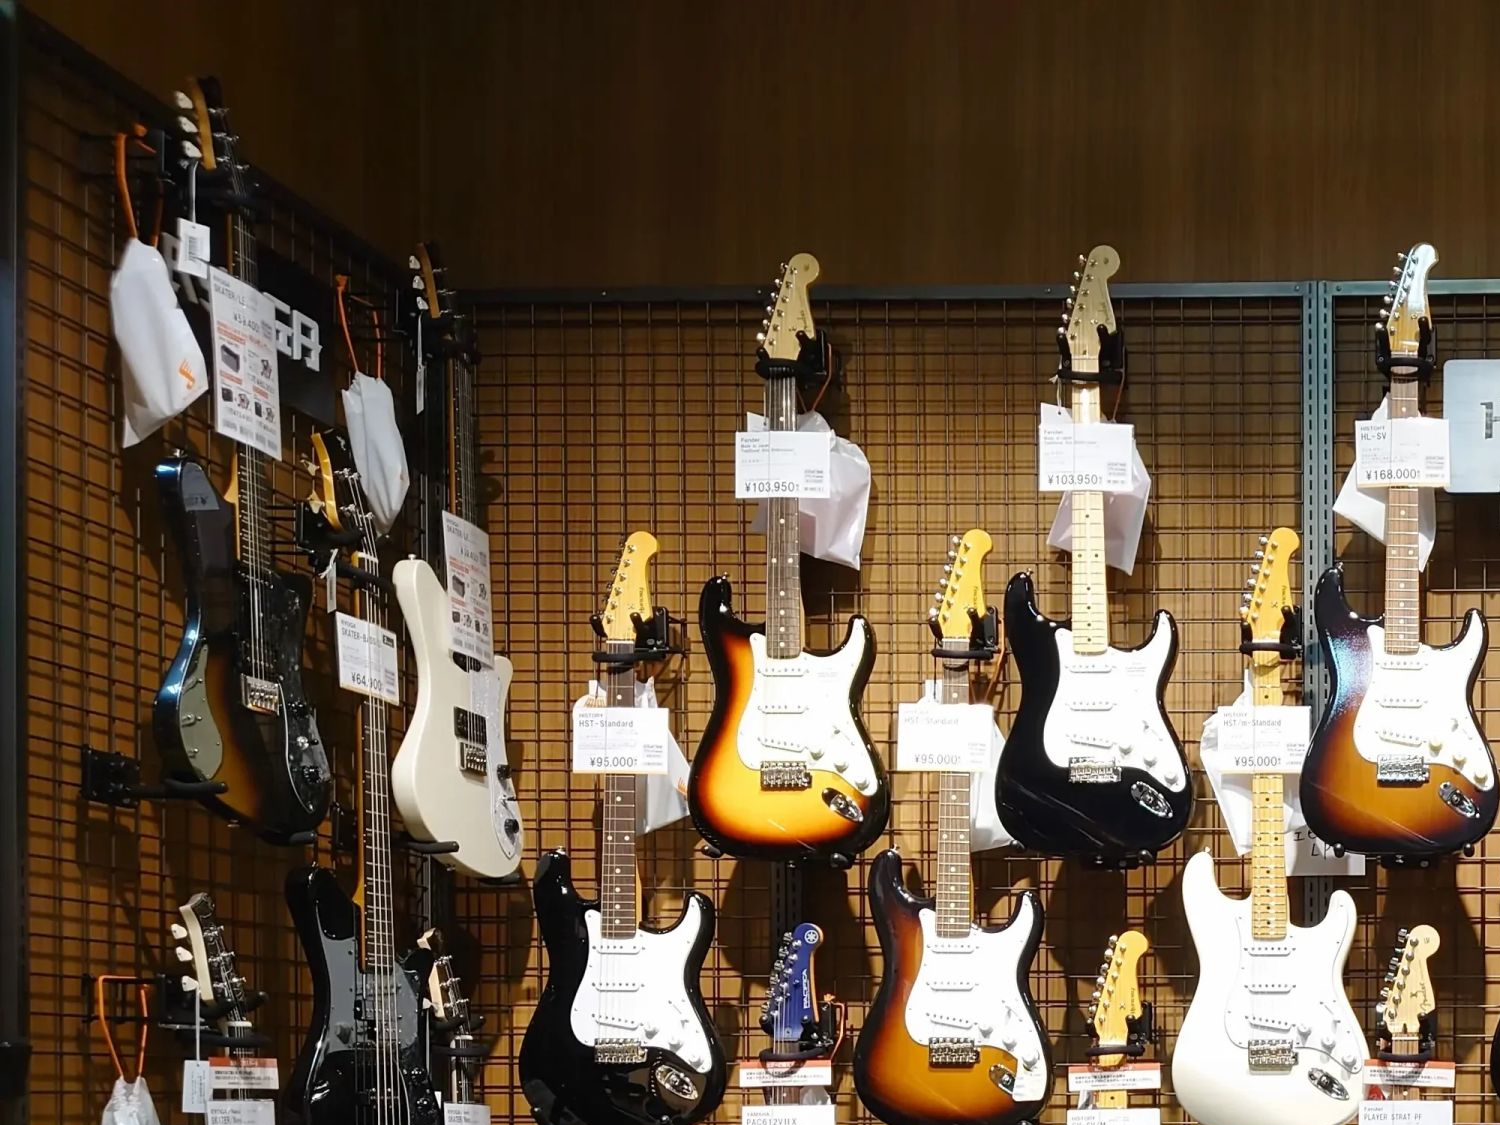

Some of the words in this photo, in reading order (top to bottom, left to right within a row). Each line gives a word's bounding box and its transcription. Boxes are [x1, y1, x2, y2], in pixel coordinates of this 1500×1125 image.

[1361, 432, 1387, 441] HL-SV
[1047, 474, 1098, 486] ¥103,950
[1366, 468, 1418, 481] ¥168,000
[744, 480, 796, 494] ¥103,950
[579, 719, 634, 728] HST-Standard
[589, 756, 634, 768] ¥95,000
[914, 753, 958, 764] ¥95,000
[1234, 756, 1278, 767] ¥95,000
[1364, 1114, 1388, 1122] PLAYER
